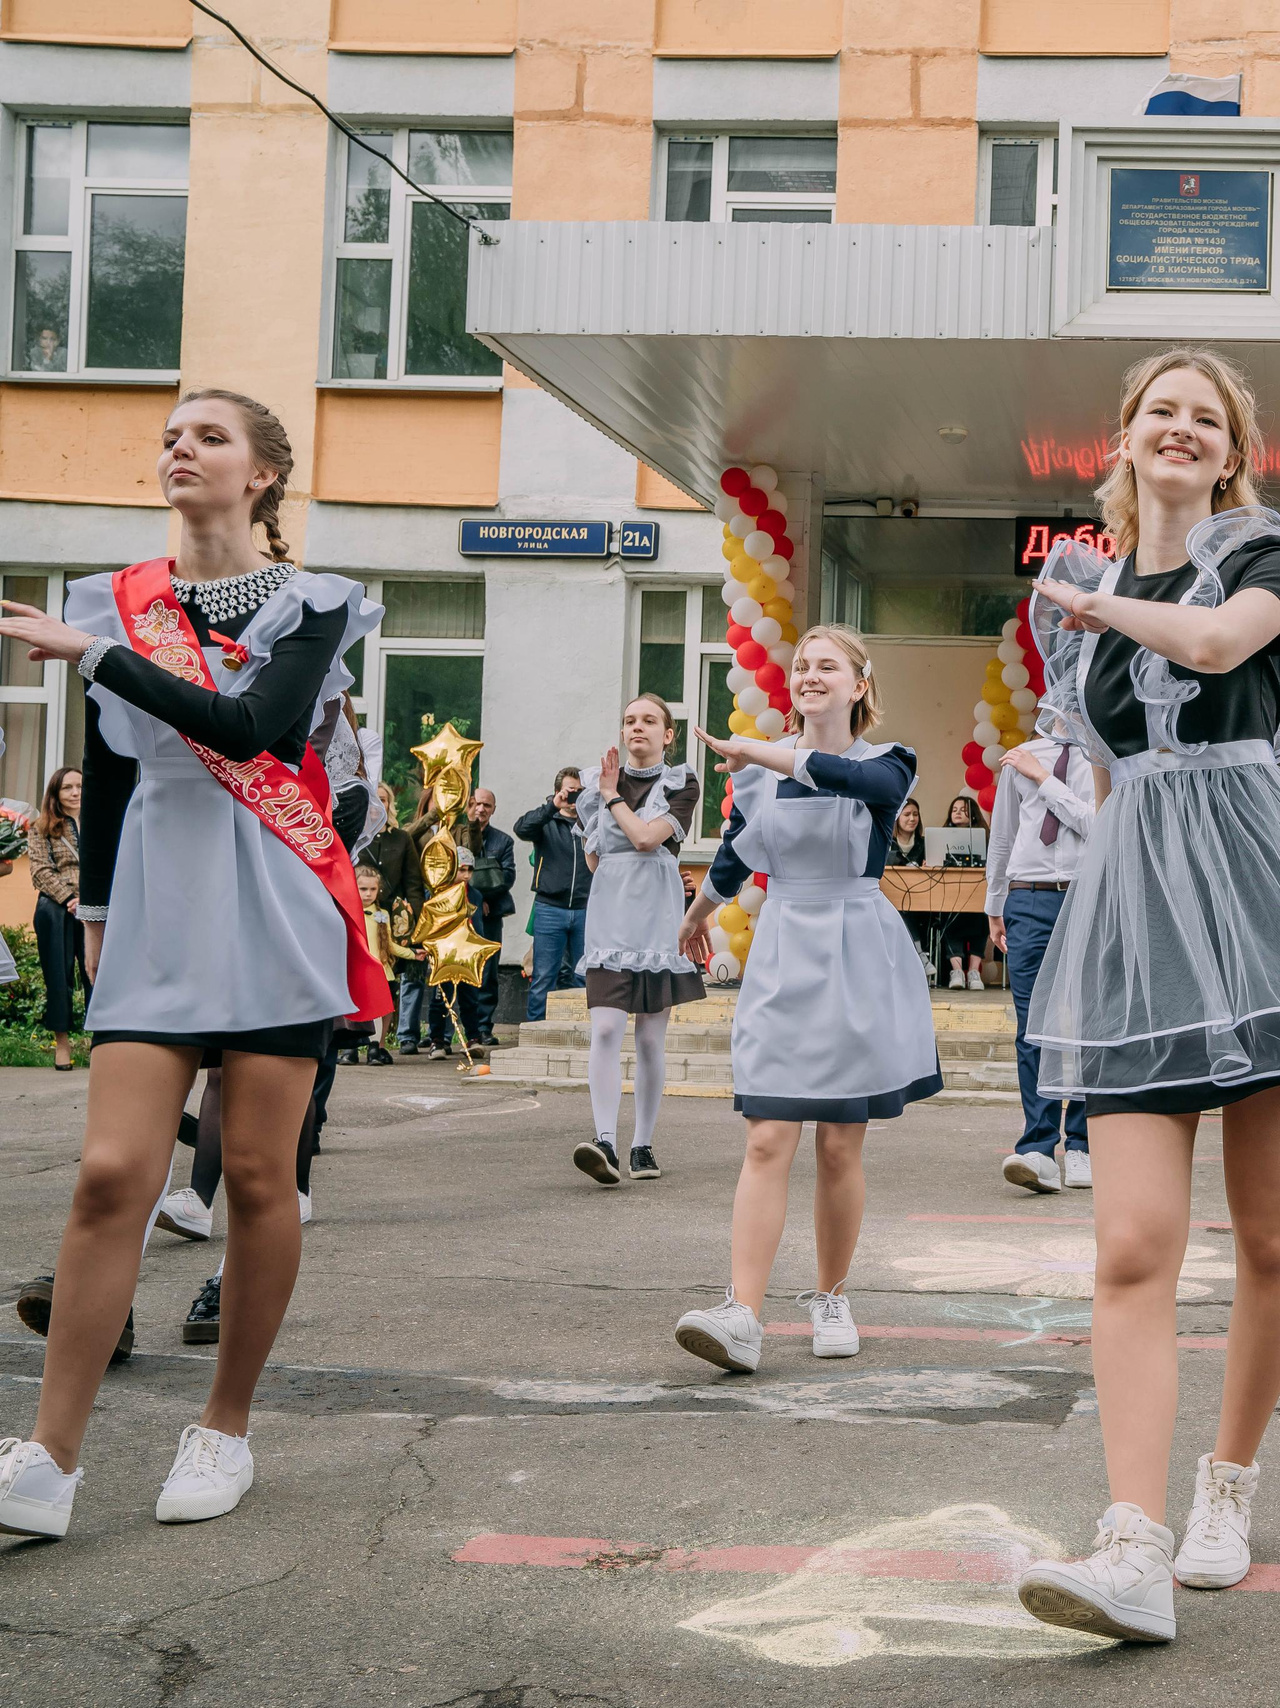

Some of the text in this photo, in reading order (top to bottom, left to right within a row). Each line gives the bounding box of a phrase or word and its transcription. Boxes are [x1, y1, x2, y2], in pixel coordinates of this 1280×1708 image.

[1119, 219, 1211, 227] ОБЩЕОБРАЗОВАТЕЛЬНОЕ
[1152, 236, 1226, 245] «ШКОЛА №1430
[1154, 246, 1223, 255] ИМЕНИ ГЕРОЯ
[1116, 255, 1261, 266] СОЦИАЛИСТИЧЕСКОГО ТРУДА
[479, 526, 588, 541] НОВГОРОДСКАЯ
[623, 530, 651, 547] 21А
[517, 541, 549, 549] УЛИЦА
[1022, 524, 1117, 566] Добр
[259, 782, 335, 860] 2022
